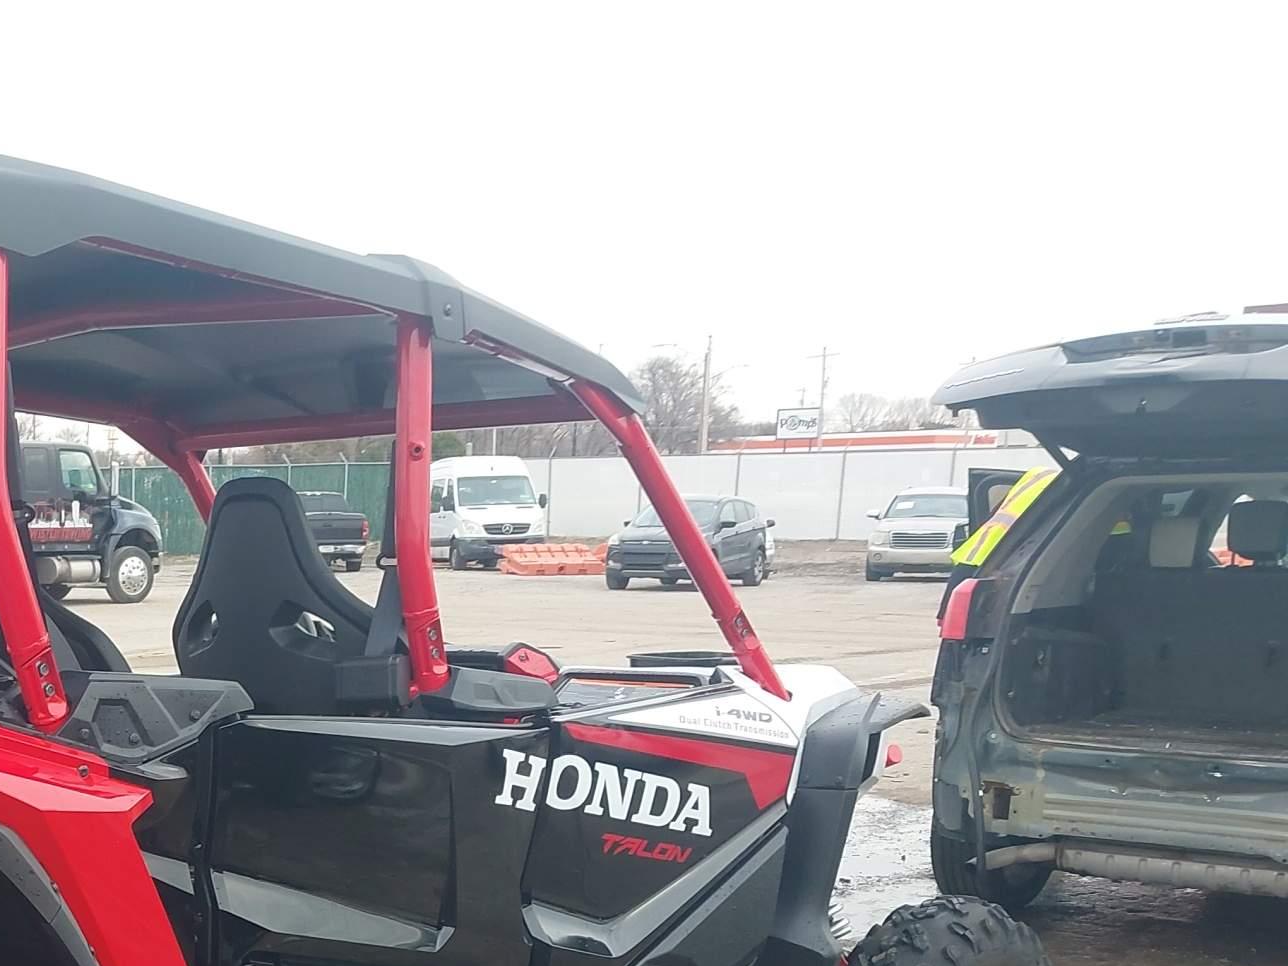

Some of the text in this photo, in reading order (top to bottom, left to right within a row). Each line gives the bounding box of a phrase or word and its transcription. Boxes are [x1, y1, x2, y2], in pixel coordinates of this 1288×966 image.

[679, 715, 790, 739] Dual Clutch Transmission
[715, 706, 773, 723] i-4WD
[495, 748, 713, 837] HONDA
[601, 833, 693, 863] TALON
